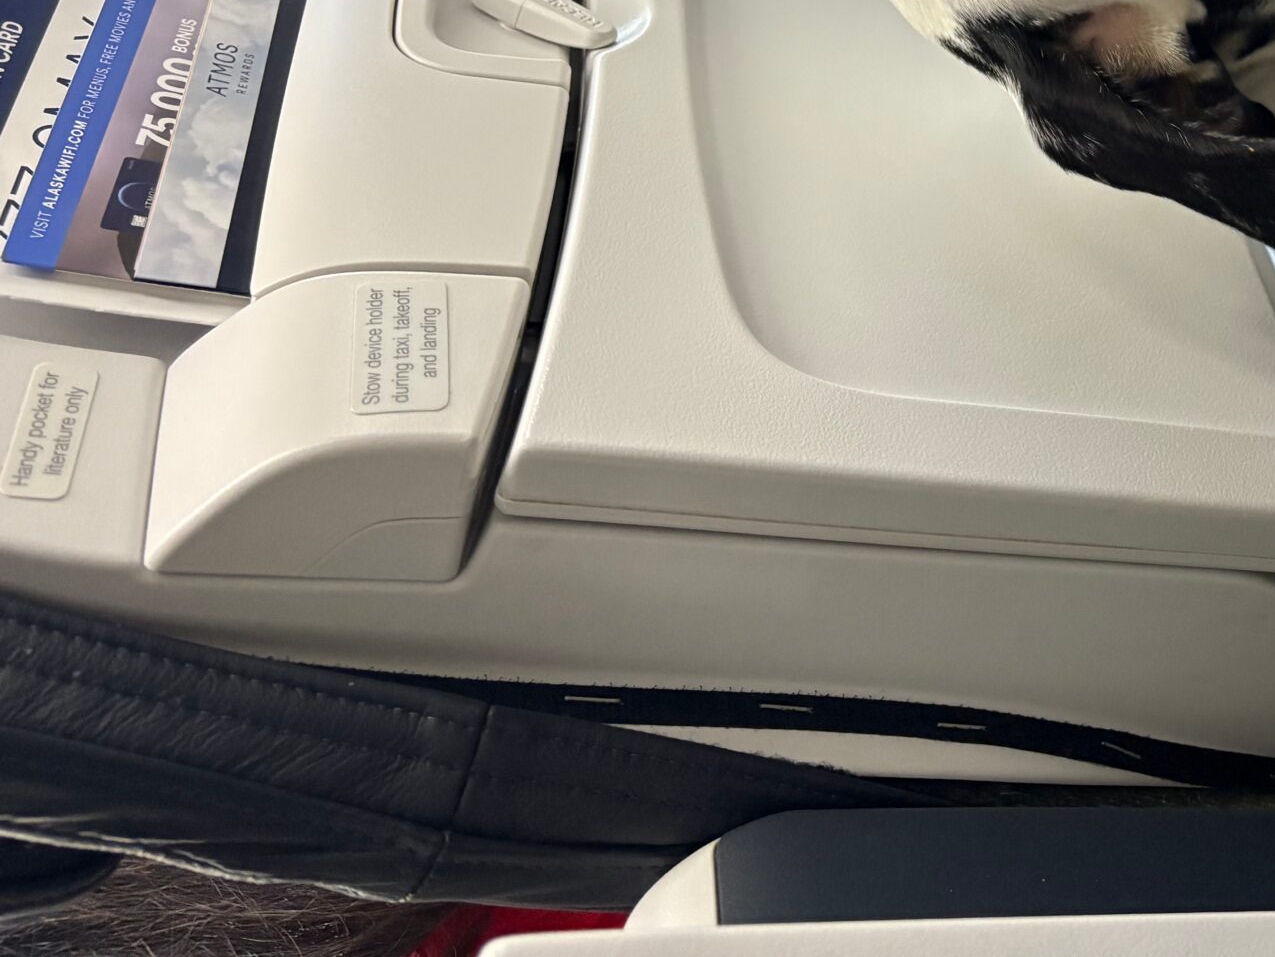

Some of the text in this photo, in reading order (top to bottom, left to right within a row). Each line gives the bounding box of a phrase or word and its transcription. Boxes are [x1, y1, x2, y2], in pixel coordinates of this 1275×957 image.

[108, 11, 131, 43] MOVIES
[171, 18, 197, 54] BONUS
[100, 43, 119, 64] FREE
[206, 42, 239, 98] ATMOS
[236, 53, 255, 95] REWARDS
[86, 67, 112, 99] MENUS,
[77, 99, 96, 120] FOR
[42, 120, 88, 210] ALASKAWIFI.COM
[29, 210, 53, 239] VISIT
[361, 288, 383, 405] Stow device holder
[391, 286, 414, 403] during taxi, takeoff,
[420, 307, 441, 378] and landing
[9, 372, 59, 486] Handy pocket for
[43, 386, 89, 476] literature only
